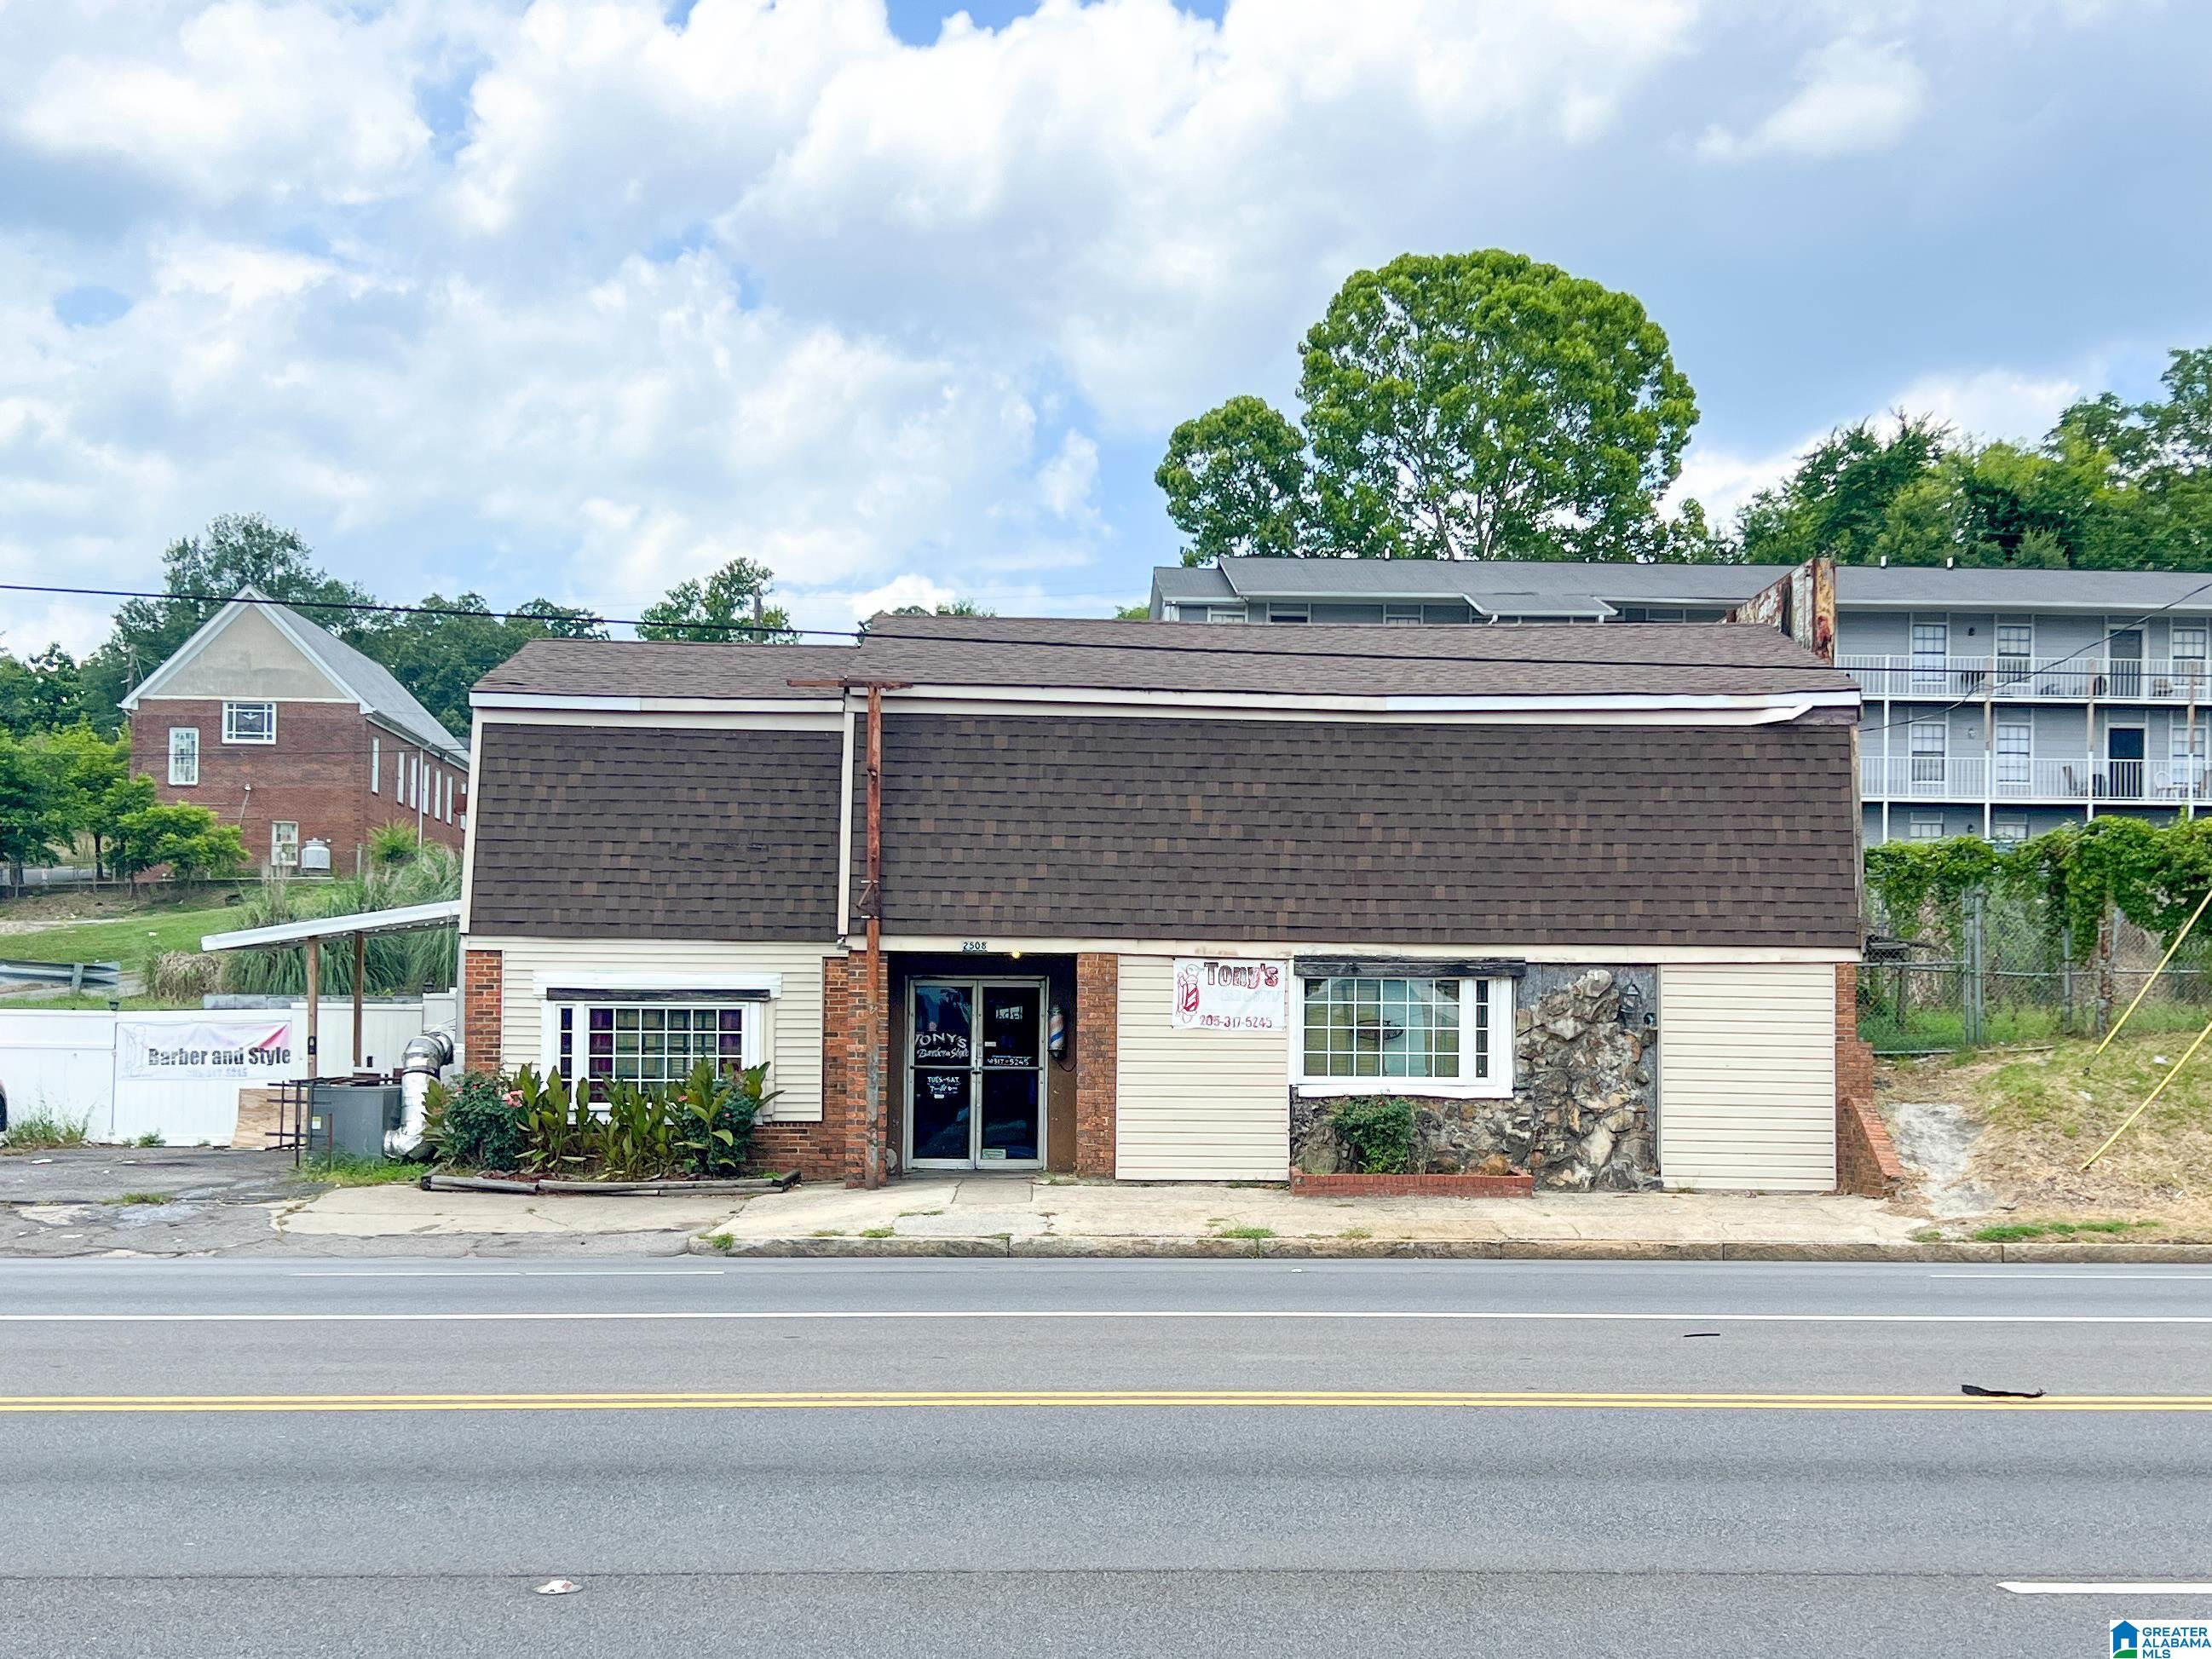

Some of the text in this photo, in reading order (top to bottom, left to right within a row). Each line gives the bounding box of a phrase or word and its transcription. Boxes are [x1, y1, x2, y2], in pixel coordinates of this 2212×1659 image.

[964, 941, 987, 950] 2508
[1203, 962, 1279, 989] Tony's
[1200, 1014, 1273, 1028] 205-317-5245
[914, 1033, 968, 1049] TONY'S
[148, 1046, 291, 1066] Barber and Style
